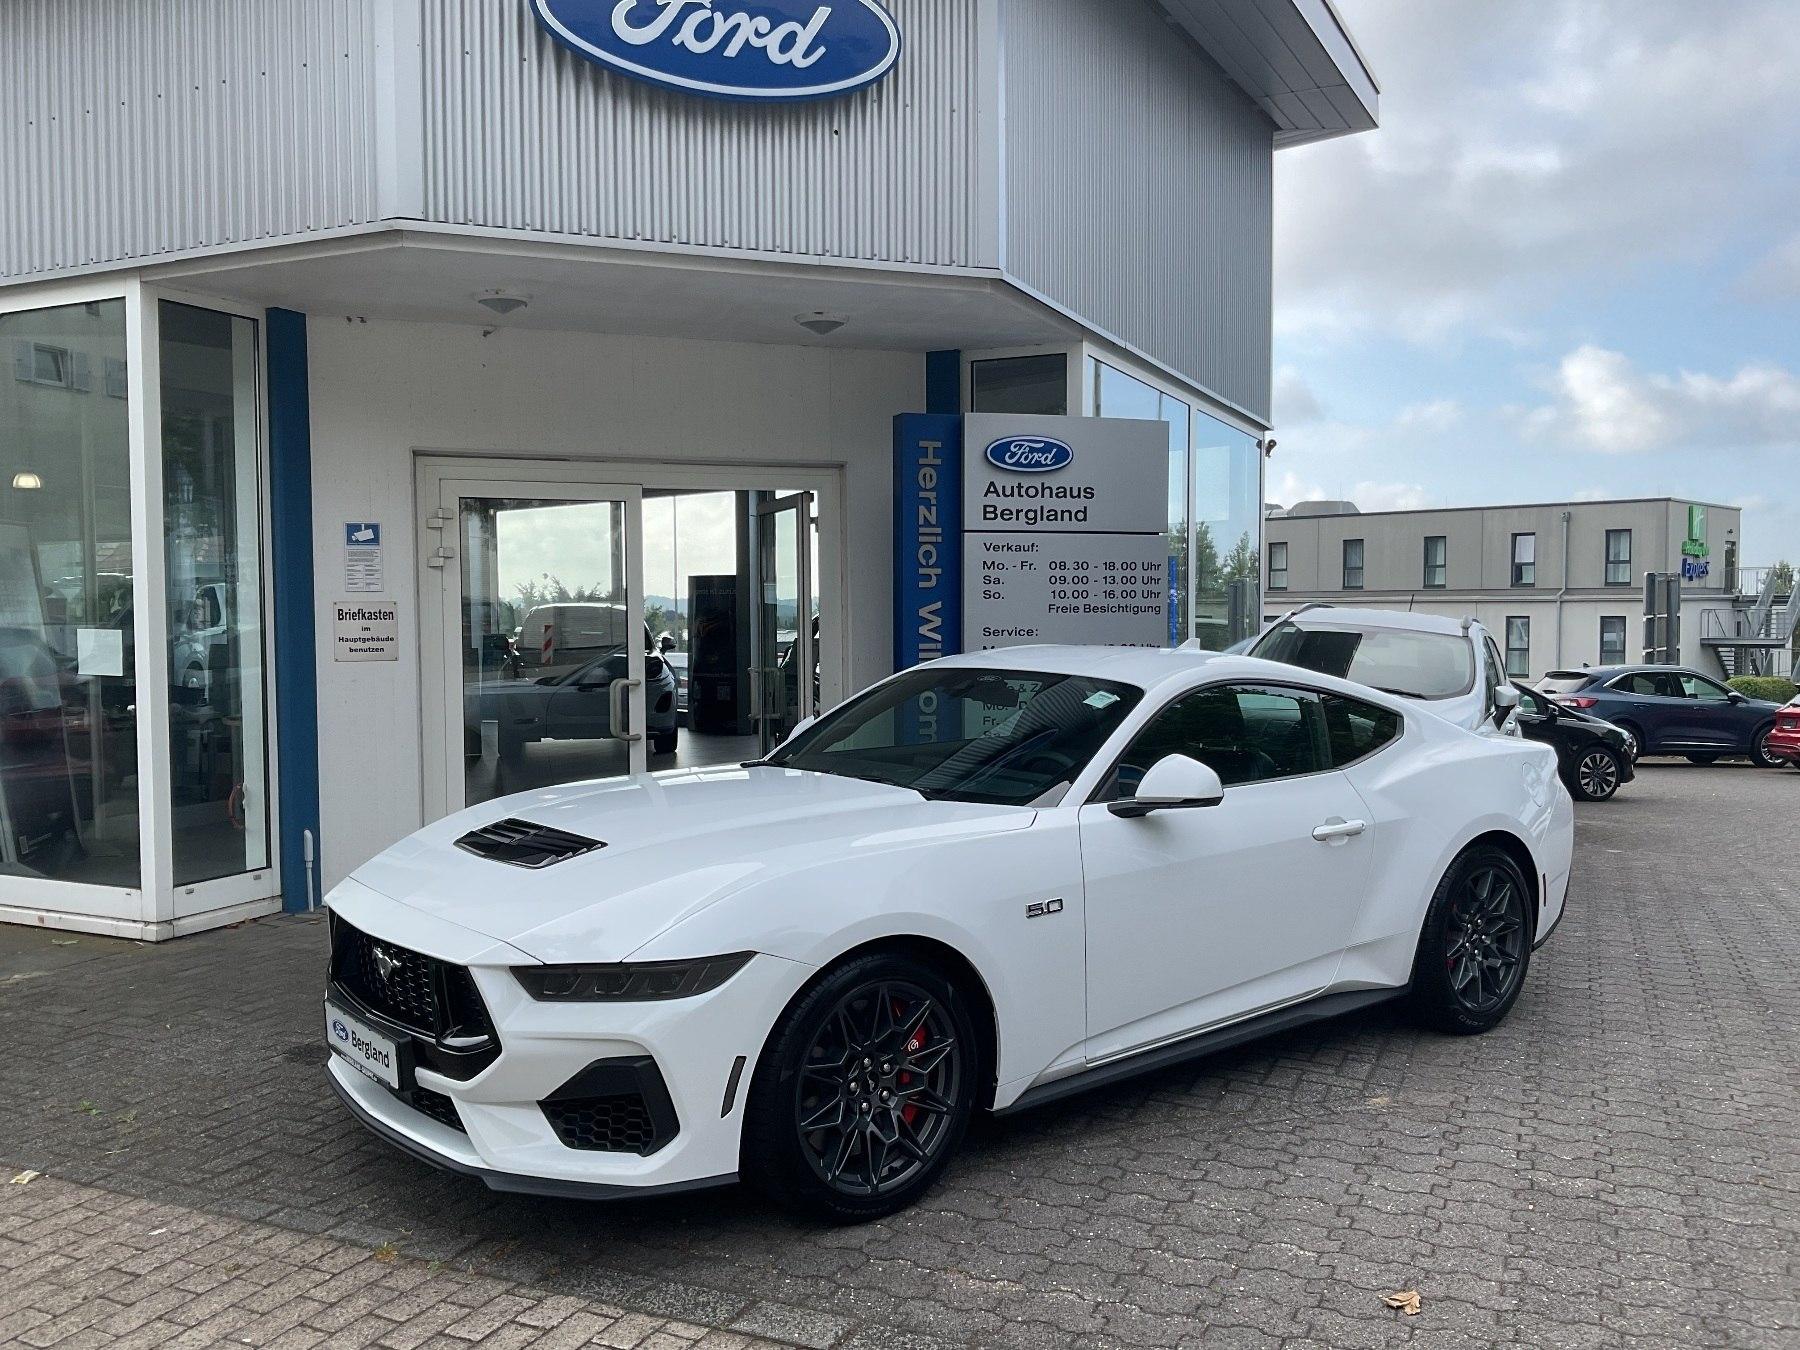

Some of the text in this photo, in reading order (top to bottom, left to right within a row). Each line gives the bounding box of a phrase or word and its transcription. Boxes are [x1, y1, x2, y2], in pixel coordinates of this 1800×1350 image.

[1005, 441, 1057, 466] Ford
[983, 481, 1096, 500] Autohaus
[918, 440, 943, 588] Herzlich
[982, 504, 1089, 526] Bergland
[983, 542, 1040, 553] Verkauf:
[982, 560, 1009, 571] Mo.
[1020, 560, 1037, 571] Fr.
[1102, 562, 1137, 572] 18.00
[1141, 561, 1162, 572] Uhr
[982, 575, 1005, 586] Sa.
[1048, 576, 1089, 586] 09.00
[1102, 576, 1137, 586] 13.00
[1141, 576, 1162, 586] Uhr
[982, 589, 1005, 600] So.
[1050, 590, 1089, 600] 10.00
[1102, 590, 1137, 600] 16.00
[1141, 589, 1162, 600] Uhr
[337, 608, 394, 621] Briefkasten
[1048, 604, 1161, 615] Freie Besichtigung
[982, 627, 1039, 638] Service:
[338, 636, 395, 644] Hauptgebäude
[351, 1030, 390, 1069] Bergland
